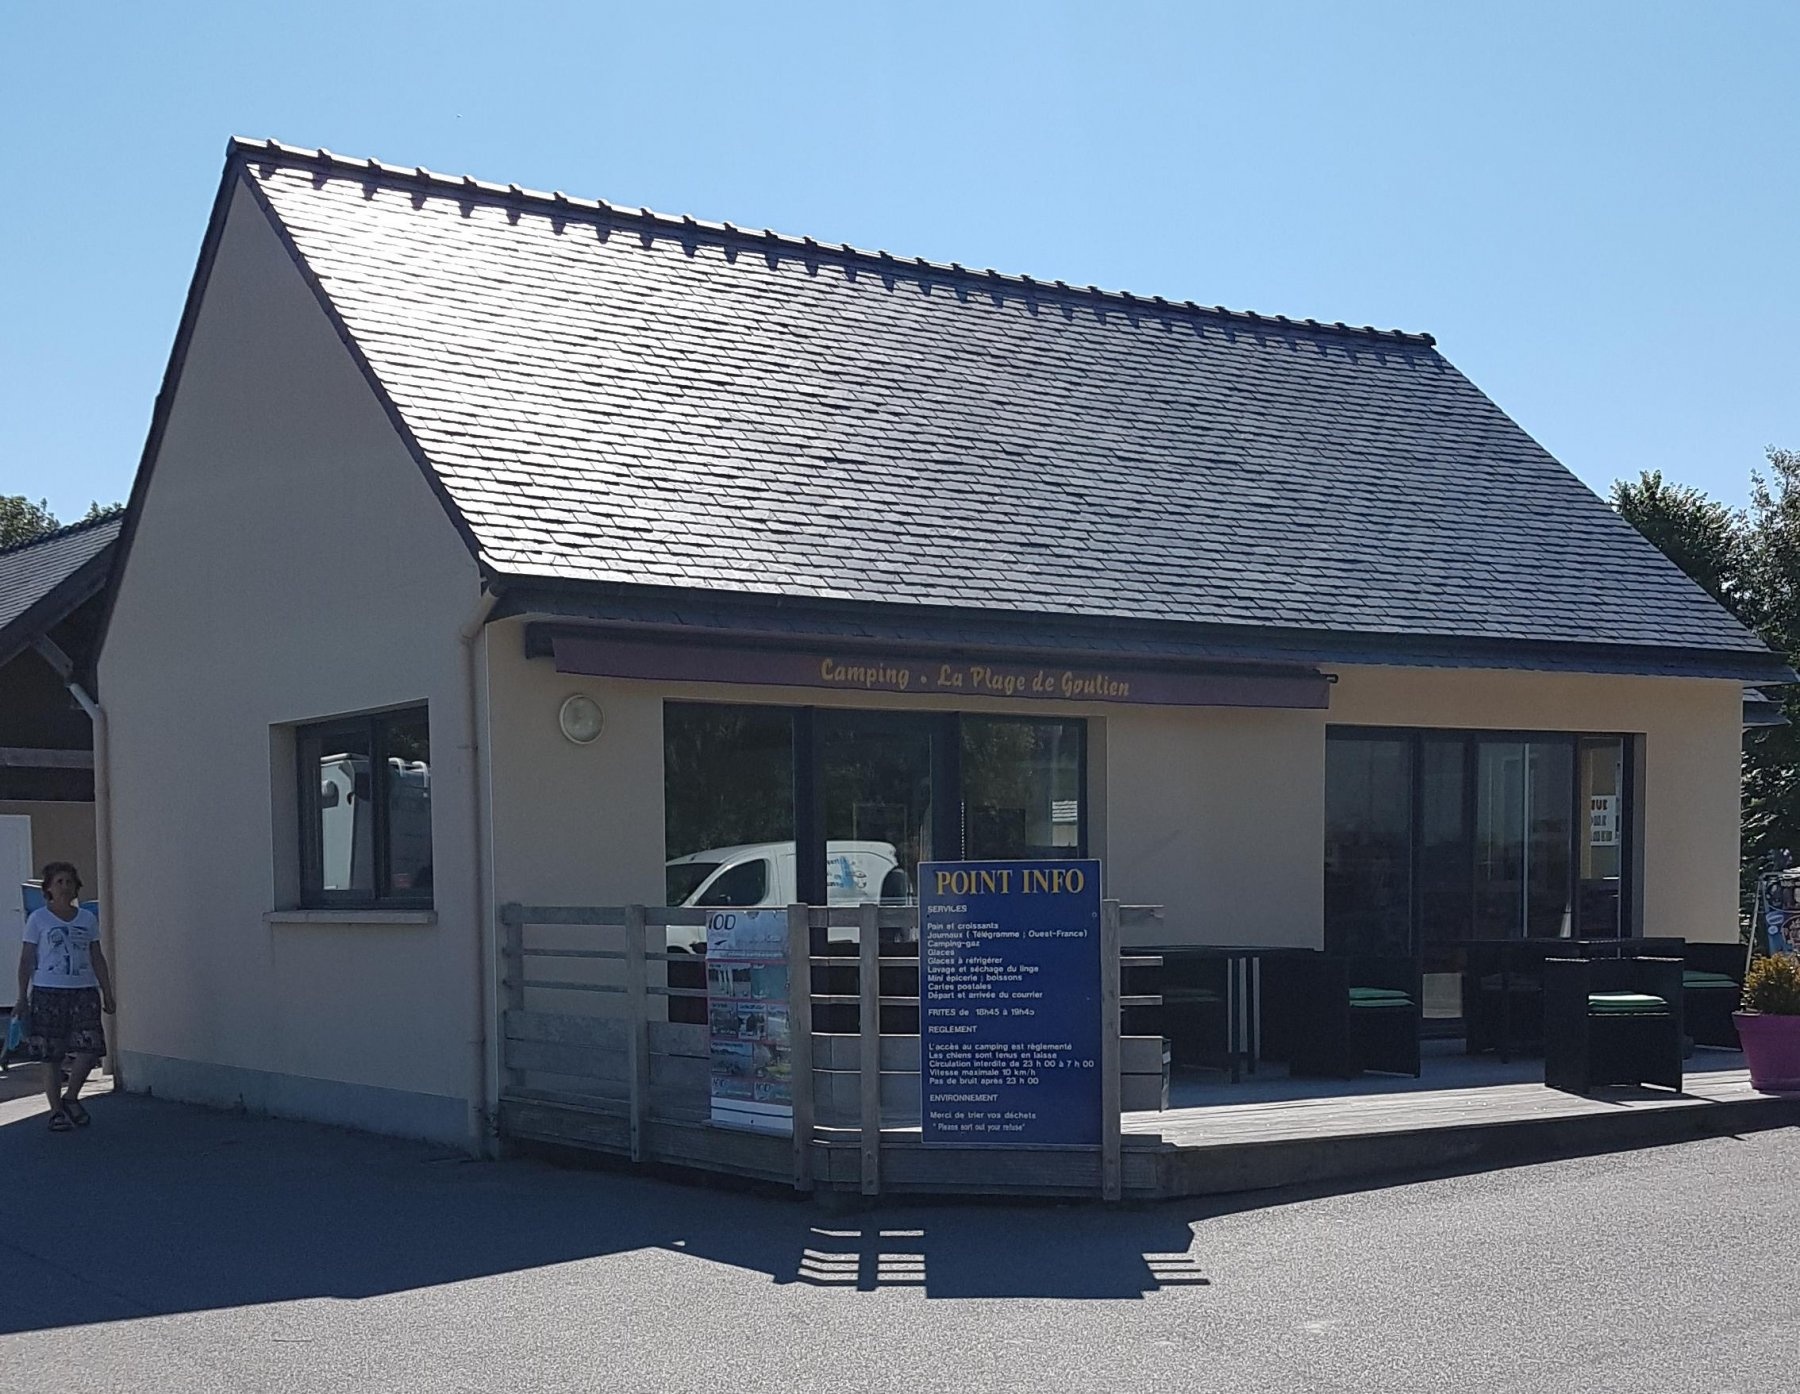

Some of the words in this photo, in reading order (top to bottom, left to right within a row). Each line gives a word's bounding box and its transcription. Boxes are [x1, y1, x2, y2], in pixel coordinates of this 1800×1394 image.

[821, 658, 909, 689] Camping
[937, 664, 963, 686] La
[970, 666, 1025, 694] Plage
[1033, 670, 1054, 692] de
[1062, 672, 1129, 697] Goulien
[936, 870, 1013, 895] POINT
[1021, 869, 1085, 893] INFO
[928, 905, 967, 913] SERVICES
[928, 931, 963, 939] Journaux
[928, 940, 980, 948] Camping-gaz
[970, 965, 1003, 973] séchage
[1019, 965, 1039, 973] linge
[946, 974, 977, 983] épicerie
[957, 983, 991, 991] postales
[928, 991, 954, 1000] Départ
[975, 1043, 1008, 1052] camping
[987, 1124, 1000, 1132] your
